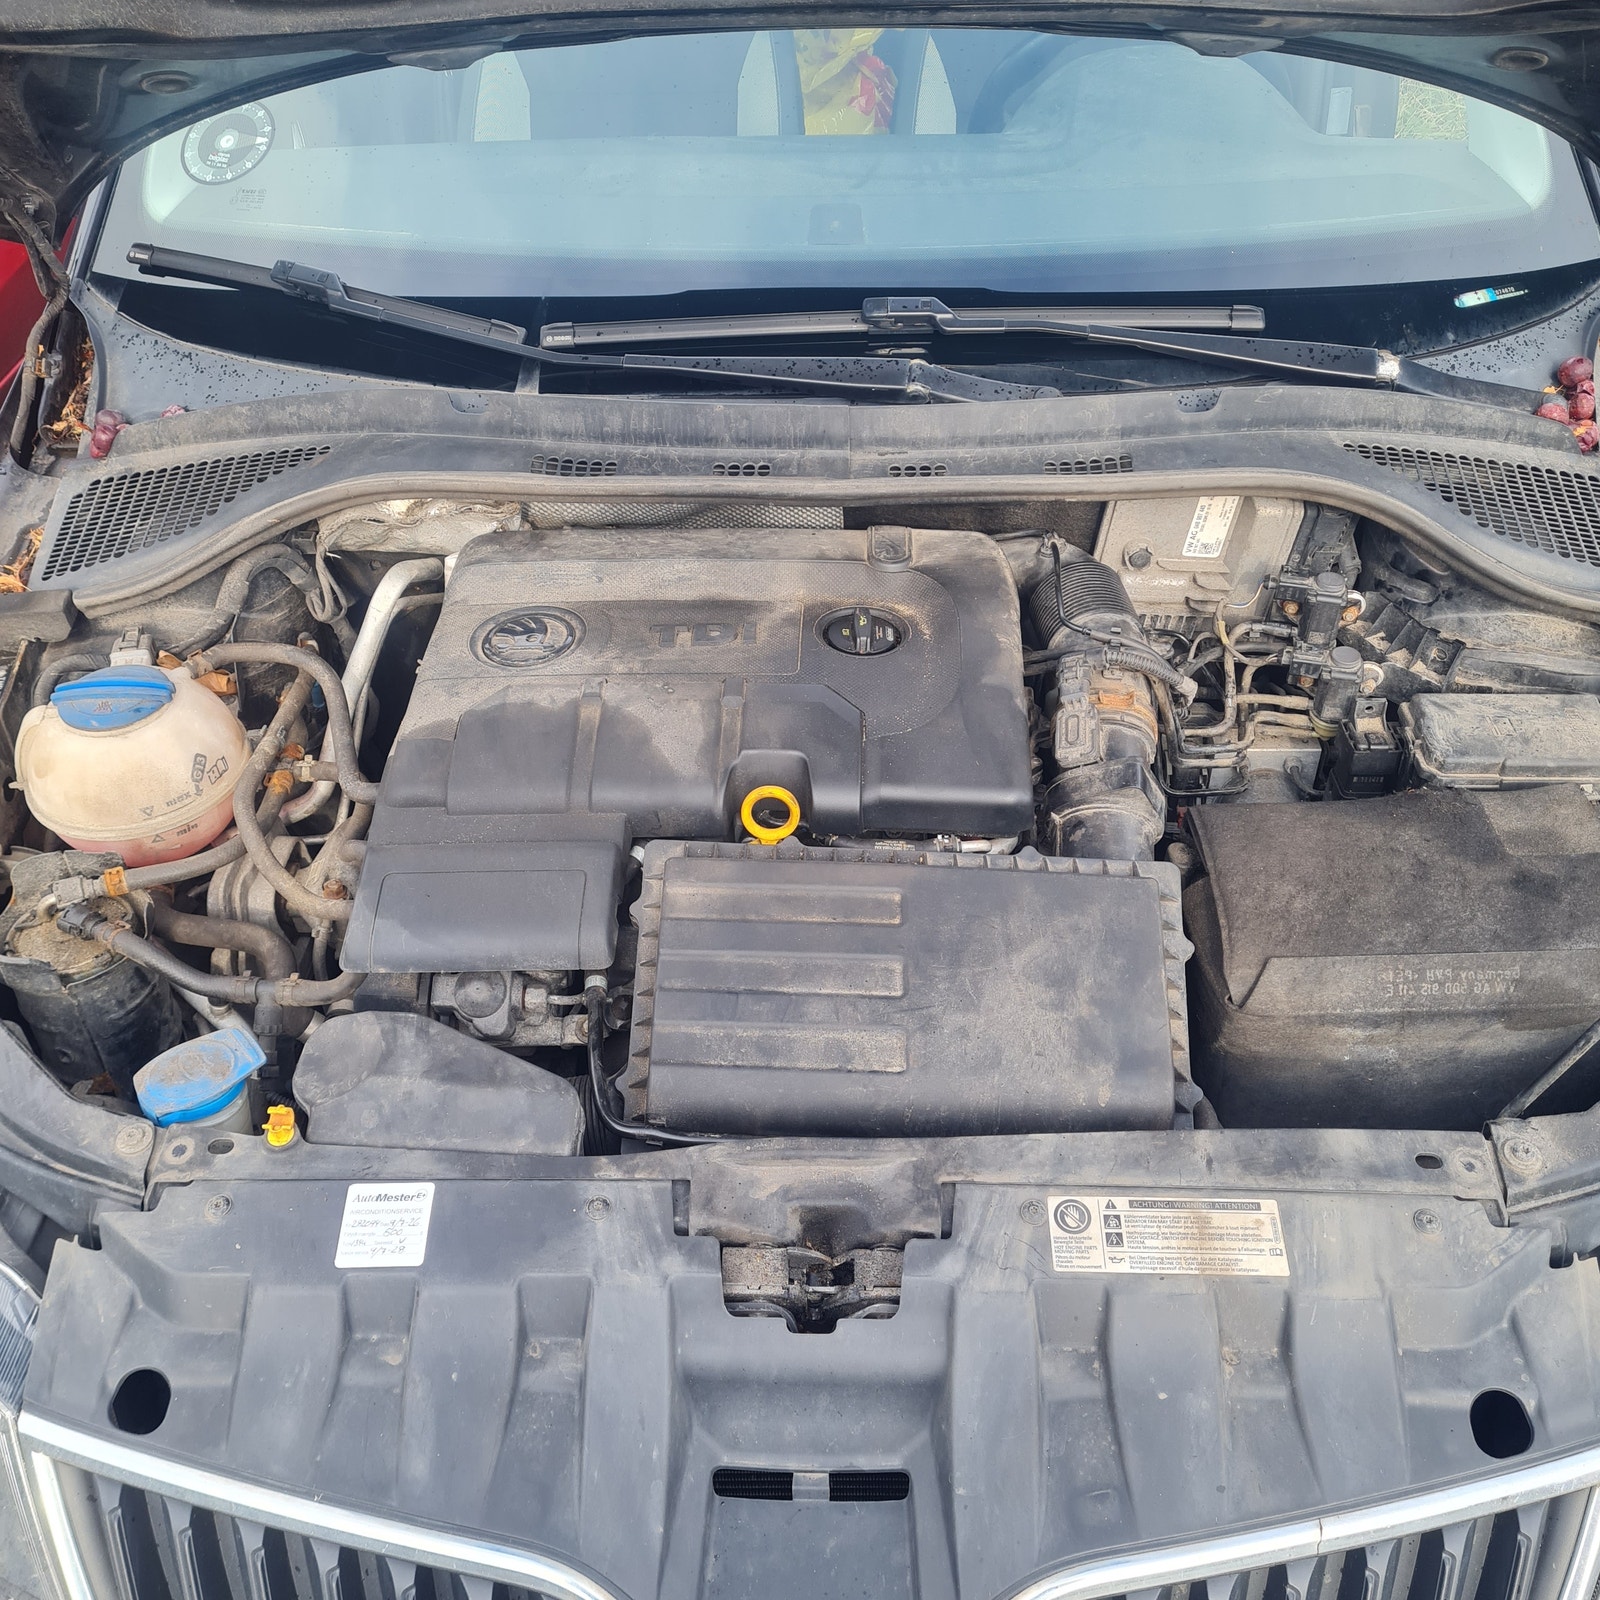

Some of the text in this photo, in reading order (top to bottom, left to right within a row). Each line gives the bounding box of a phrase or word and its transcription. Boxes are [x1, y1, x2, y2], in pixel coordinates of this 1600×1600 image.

[1185, 541, 1194, 553] VW
[1190, 531, 1199, 541] AG
[649, 622, 757, 648] TDI
[194, 756, 205, 780] G13
[165, 791, 192, 807] max
[176, 823, 199, 837] min
[352, 1193, 416, 1202] AutoMester
[1173, 1201, 1213, 1209] WARNING!
[1214, 1202, 1259, 1210] ATTENTION!
